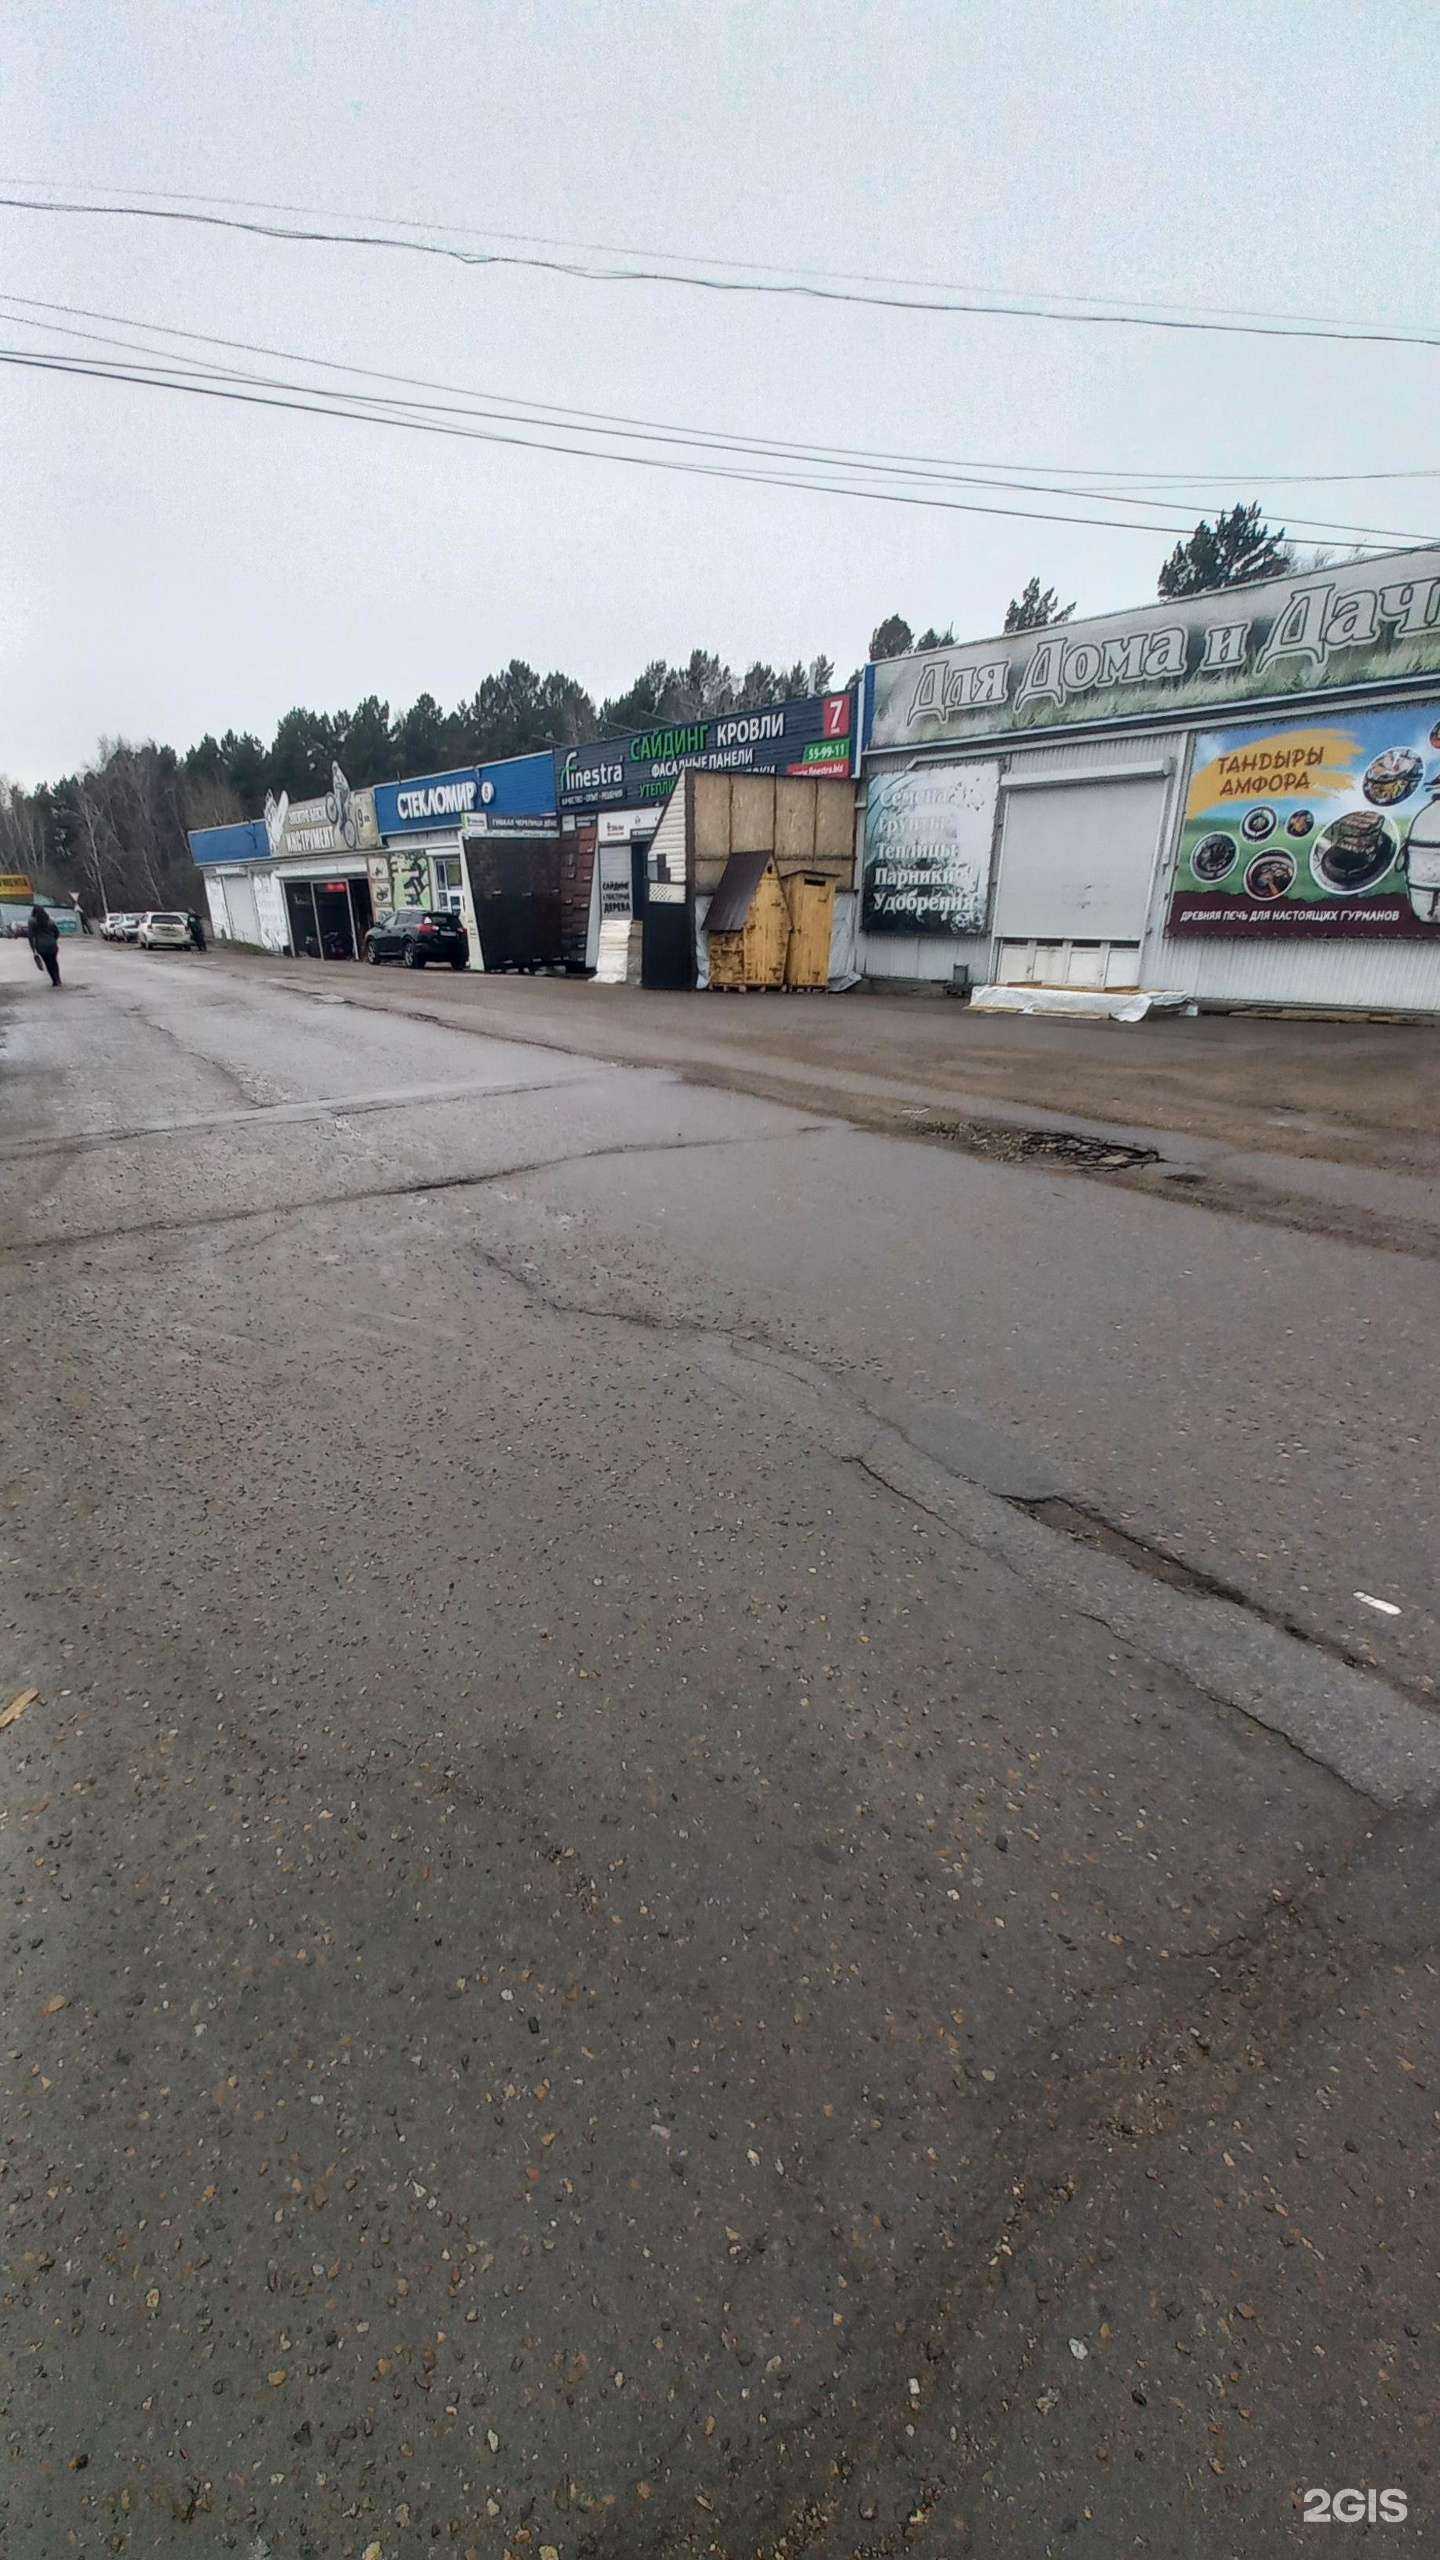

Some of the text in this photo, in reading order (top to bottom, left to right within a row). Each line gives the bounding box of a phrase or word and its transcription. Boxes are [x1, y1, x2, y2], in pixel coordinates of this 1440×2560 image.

[907, 576, 1440, 727] Для Дома и Дач
[830, 700, 843, 729] 7
[630, 712, 784, 761] САЙДИНГ КРОВЛИ
[708, 749, 754, 769] ПАНЕЛИ
[808, 743, 845, 761] 55-99-11
[1218, 746, 1324, 774] ТАНДЫРЫ
[561, 751, 623, 791] finestra
[1219, 771, 1310, 796] АМФОРА
[397, 781, 477, 819] СТЕКЛОМИР
[639, 779, 675, 798] УТЕПЛИ
[1180, 910, 1400, 922] ДРЕВНЯЯ ПЕЧЬ ДЛЯ НАСТОЯЩИХ ГУРМАНОВ
